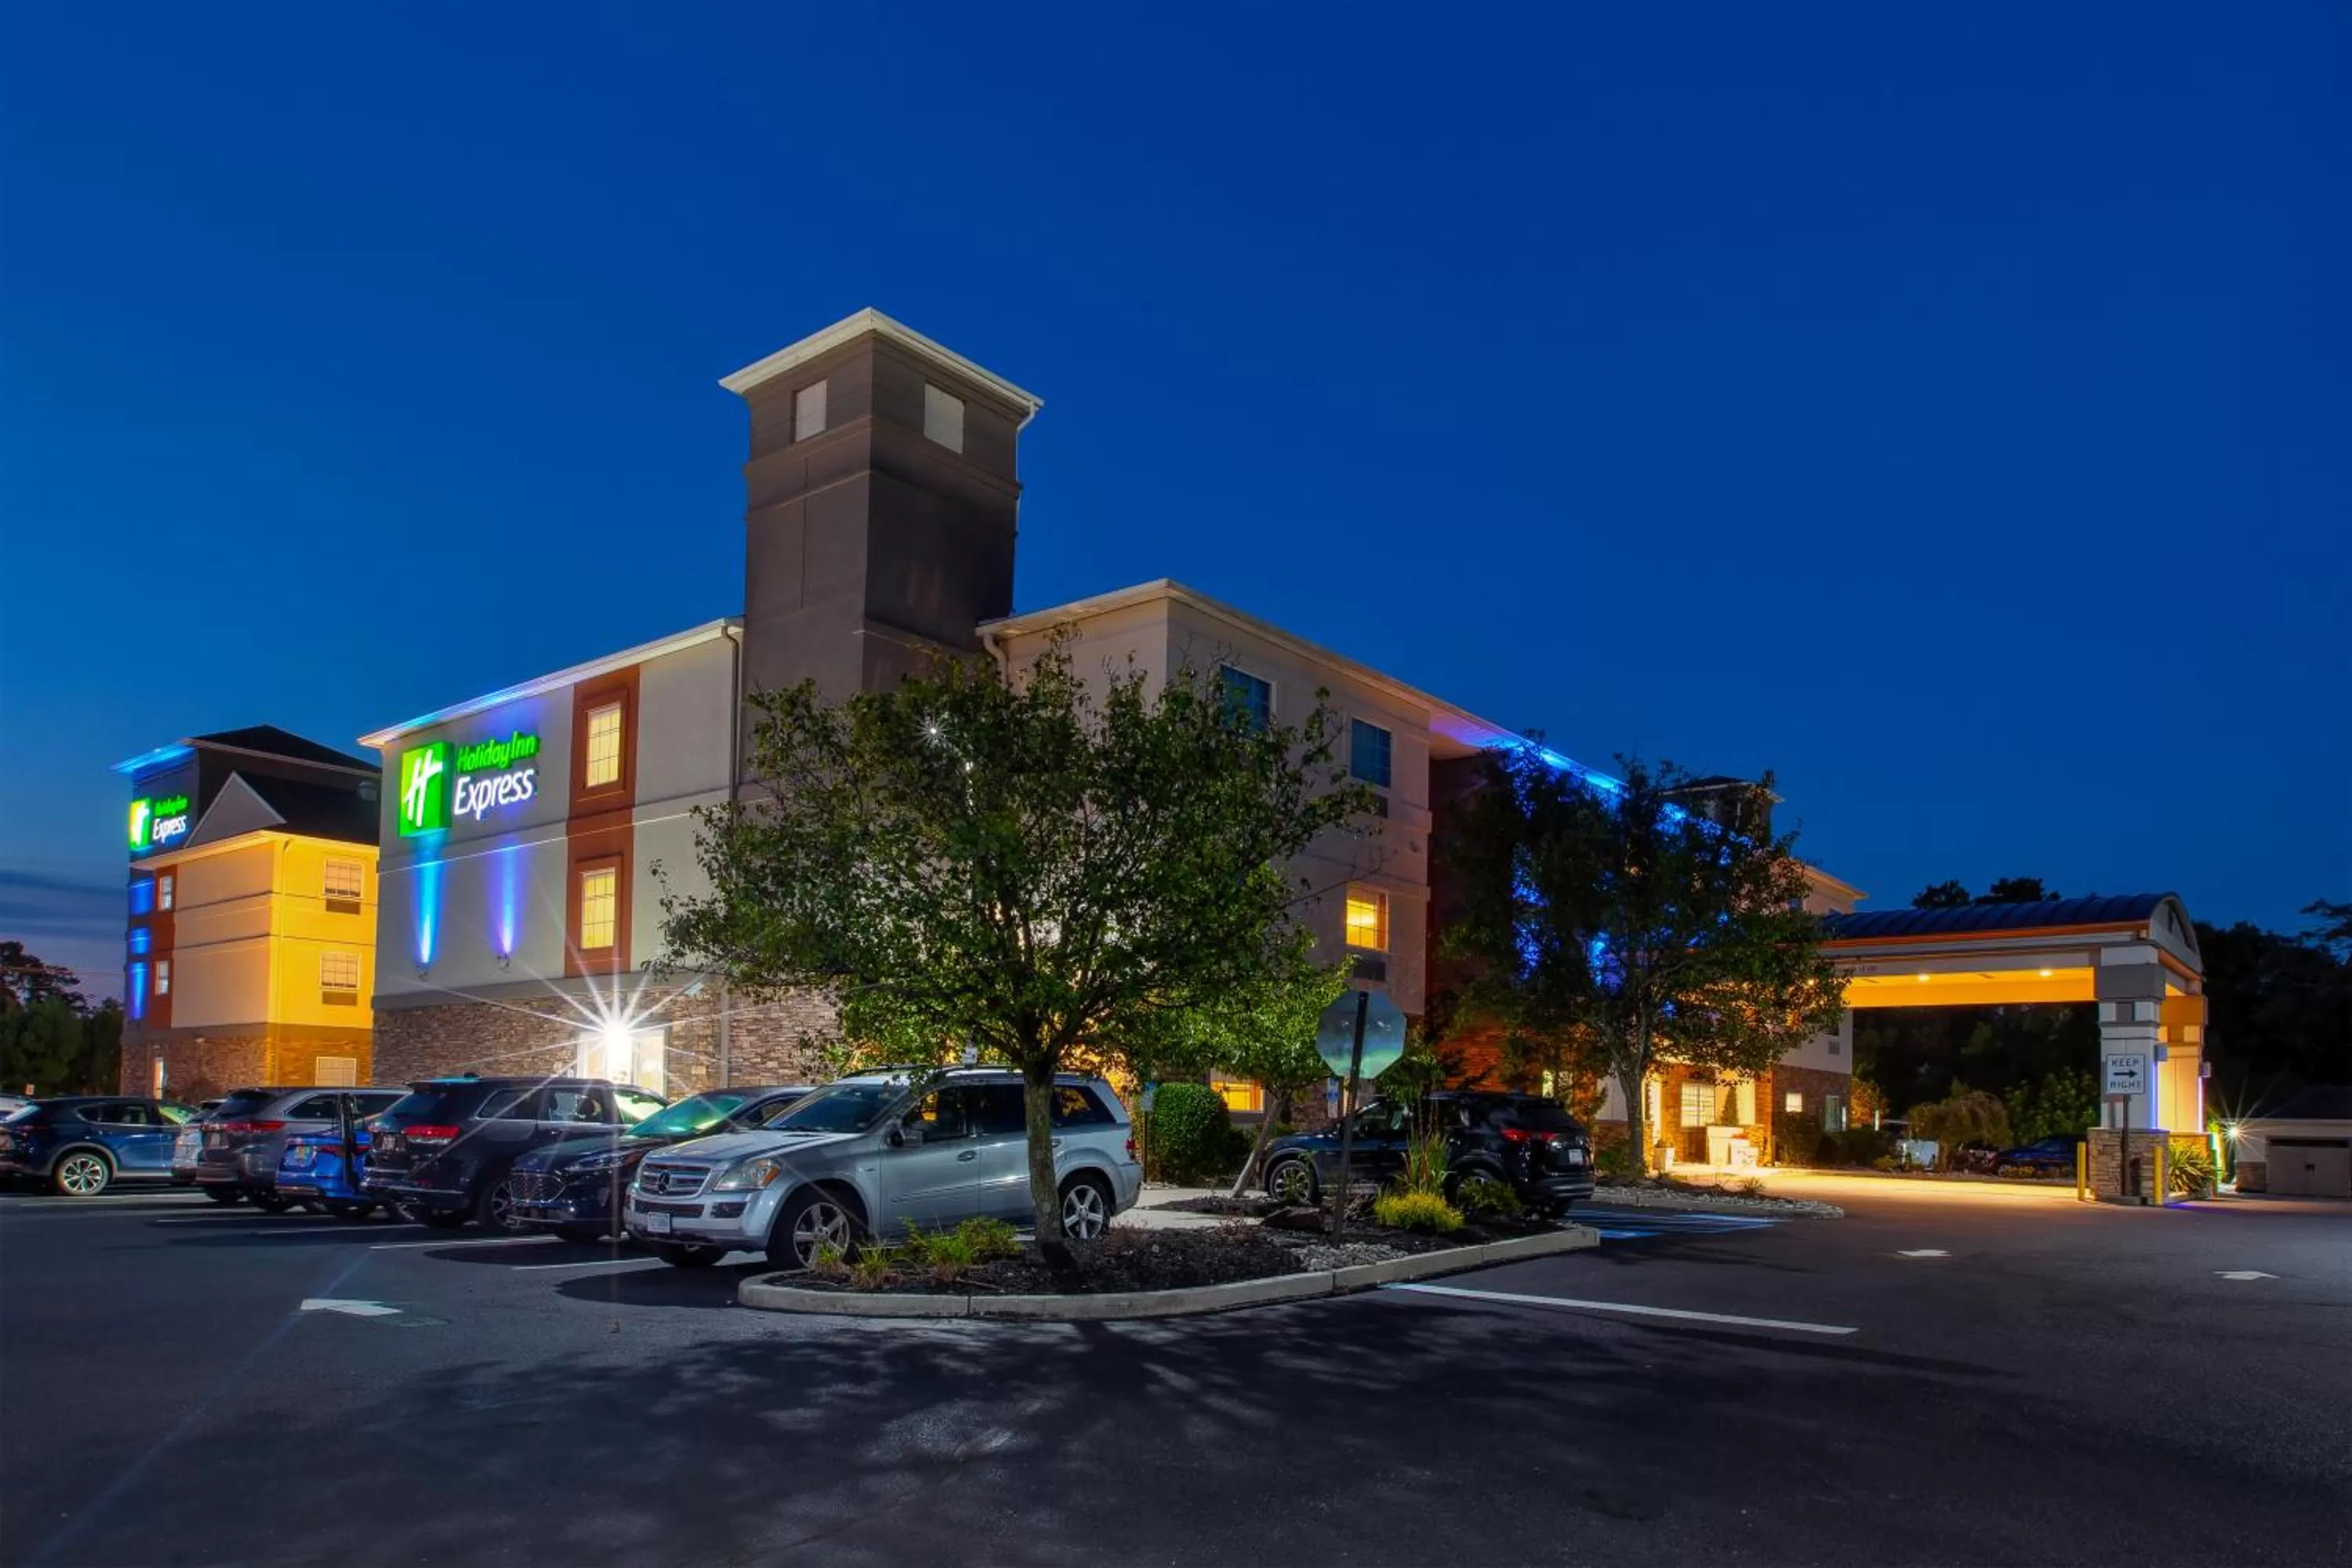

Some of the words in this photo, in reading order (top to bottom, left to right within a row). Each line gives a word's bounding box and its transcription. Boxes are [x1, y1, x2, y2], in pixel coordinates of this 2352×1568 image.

[456, 739, 510, 771] Holiday
[510, 731, 538, 759] Inn
[453, 768, 535, 821] Express
[2111, 1058, 2140, 1067] KEEP
